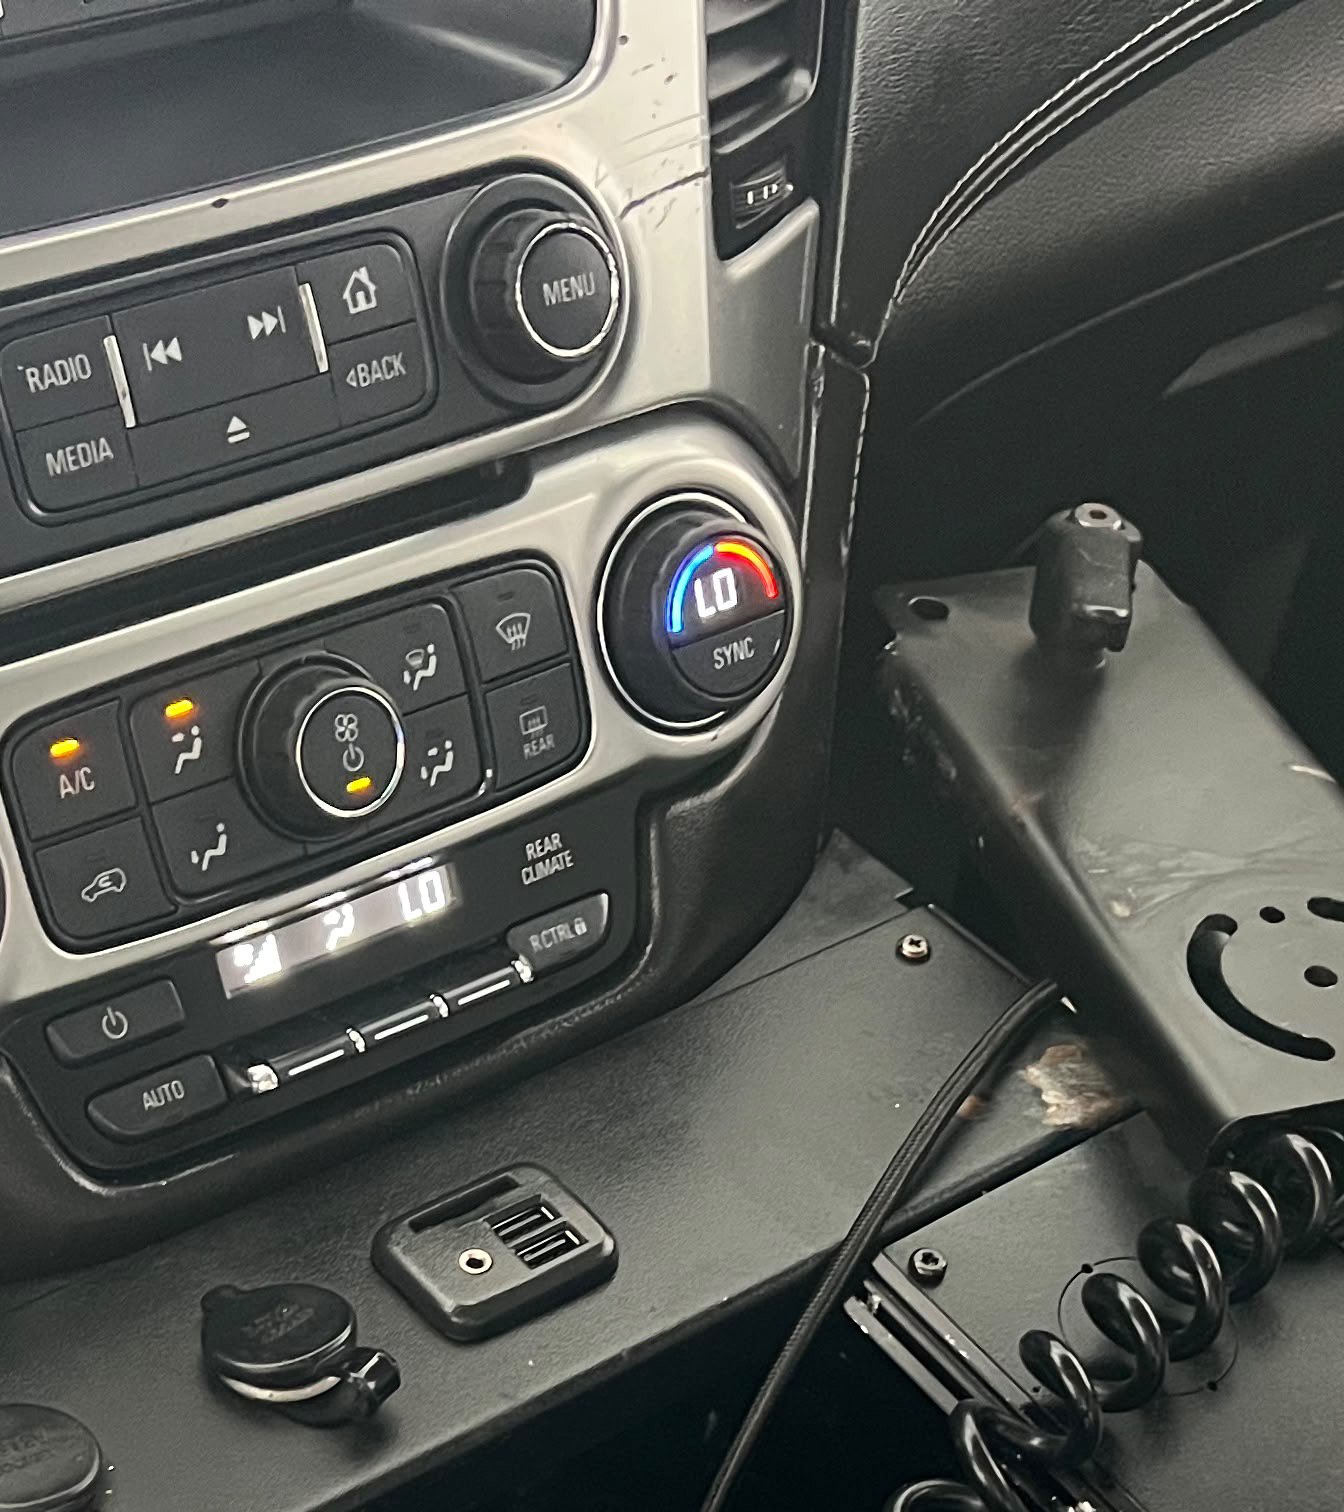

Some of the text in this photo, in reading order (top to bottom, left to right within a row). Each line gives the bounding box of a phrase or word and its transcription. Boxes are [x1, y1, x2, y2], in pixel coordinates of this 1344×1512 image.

[543, 272, 595, 306] MENU
[25, 354, 91, 393] RADIO
[357, 352, 406, 387] BACK
[46, 437, 114, 476] MEDIA
[694, 567, 737, 618] LO
[713, 637, 755, 670] SYNC
[523, 734, 555, 760] REAR
[59, 767, 95, 798] A/C
[525, 833, 563, 861] REAR
[521, 850, 574, 885] CLIMATE
[397, 869, 447, 922] LO
[142, 1080, 185, 1111] AUTO
